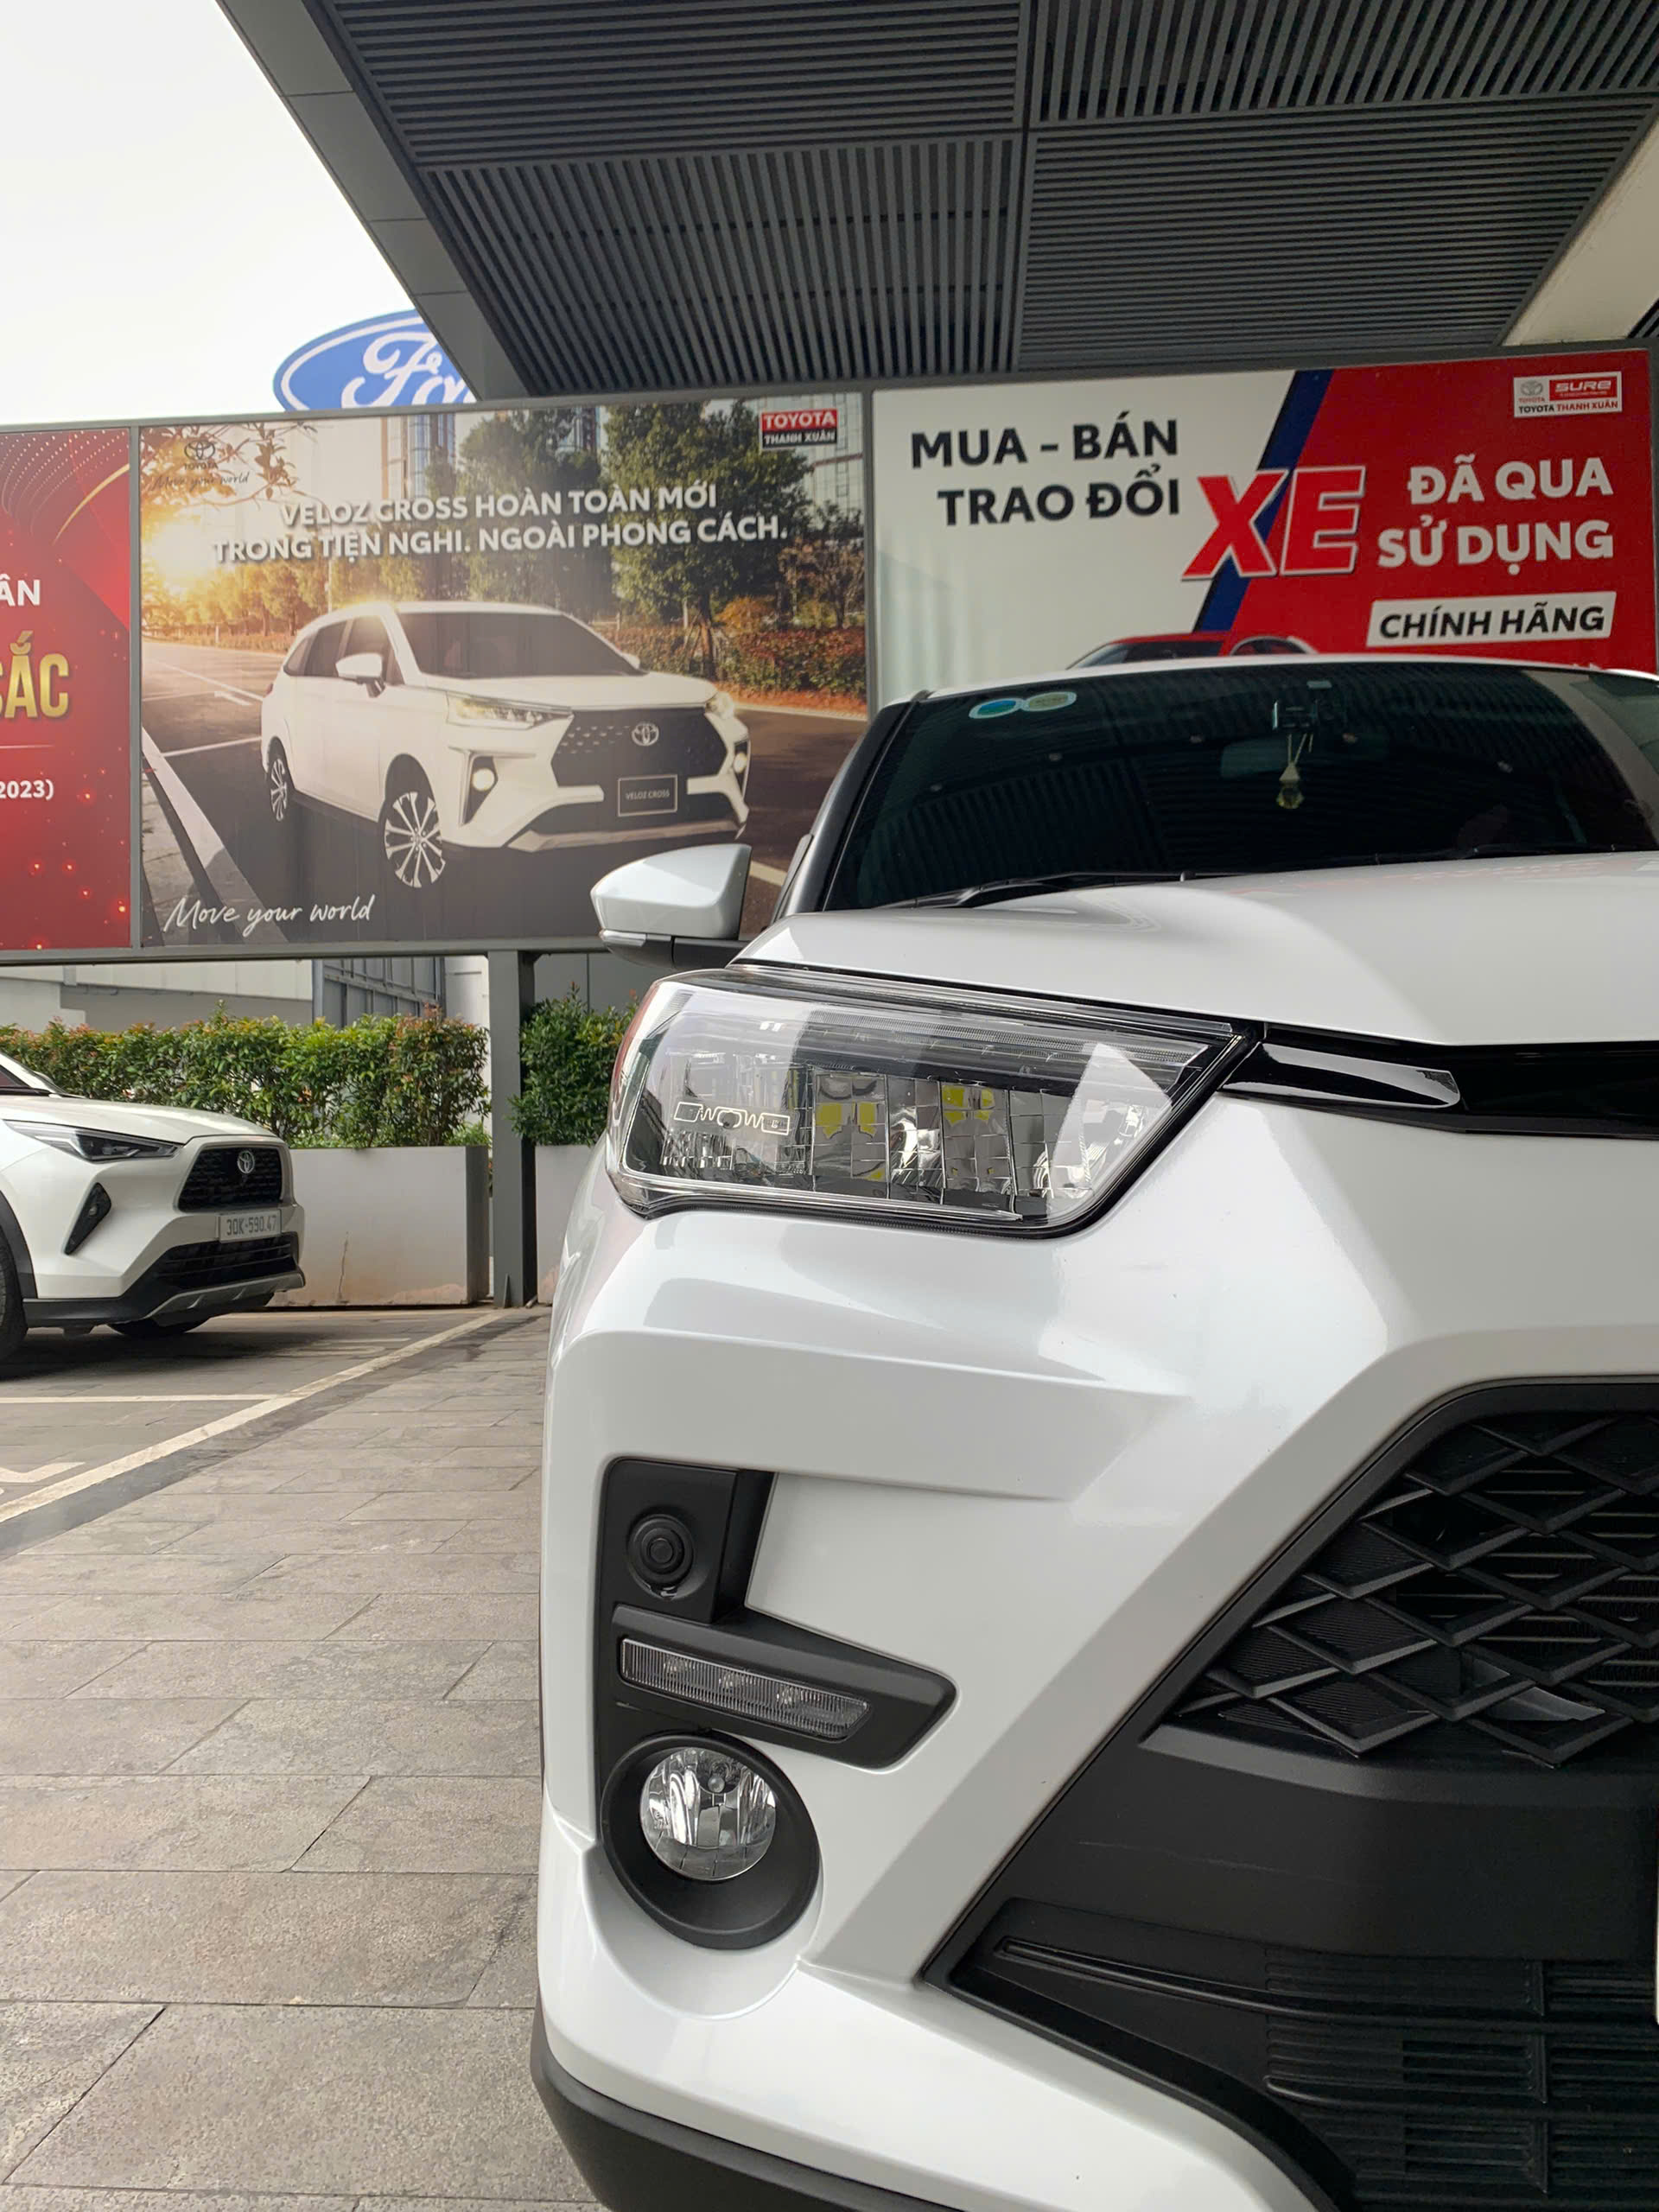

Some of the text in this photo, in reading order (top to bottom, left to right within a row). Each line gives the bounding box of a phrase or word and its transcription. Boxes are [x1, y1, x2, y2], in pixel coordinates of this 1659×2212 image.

[763, 411, 836, 429] TOYOTA
[1519, 398, 1618, 414] TOYOTA THANH XUÂN
[764, 433, 802, 445] THANH
[912, 428, 1028, 468] MUA
[1073, 410, 1177, 461] BÁN
[281, 480, 717, 526] VELOZ CROSS HOÀN TOÀN MỚI
[937, 463, 1179, 526] TRAO ĐỔI
[1407, 453, 1614, 505] ĐÃ QUA
[214, 512, 788, 563] TRONG TIỆN NGHI. NGOÀI PHONG CÁCH.
[1181, 465, 1366, 581] XE
[1377, 513, 1614, 575] SỬ DỤNG
[1379, 601, 1605, 639] CHÍNH HÃNG
[0, 630, 70, 720] ẮC
[163, 893, 376, 938] Move your world
